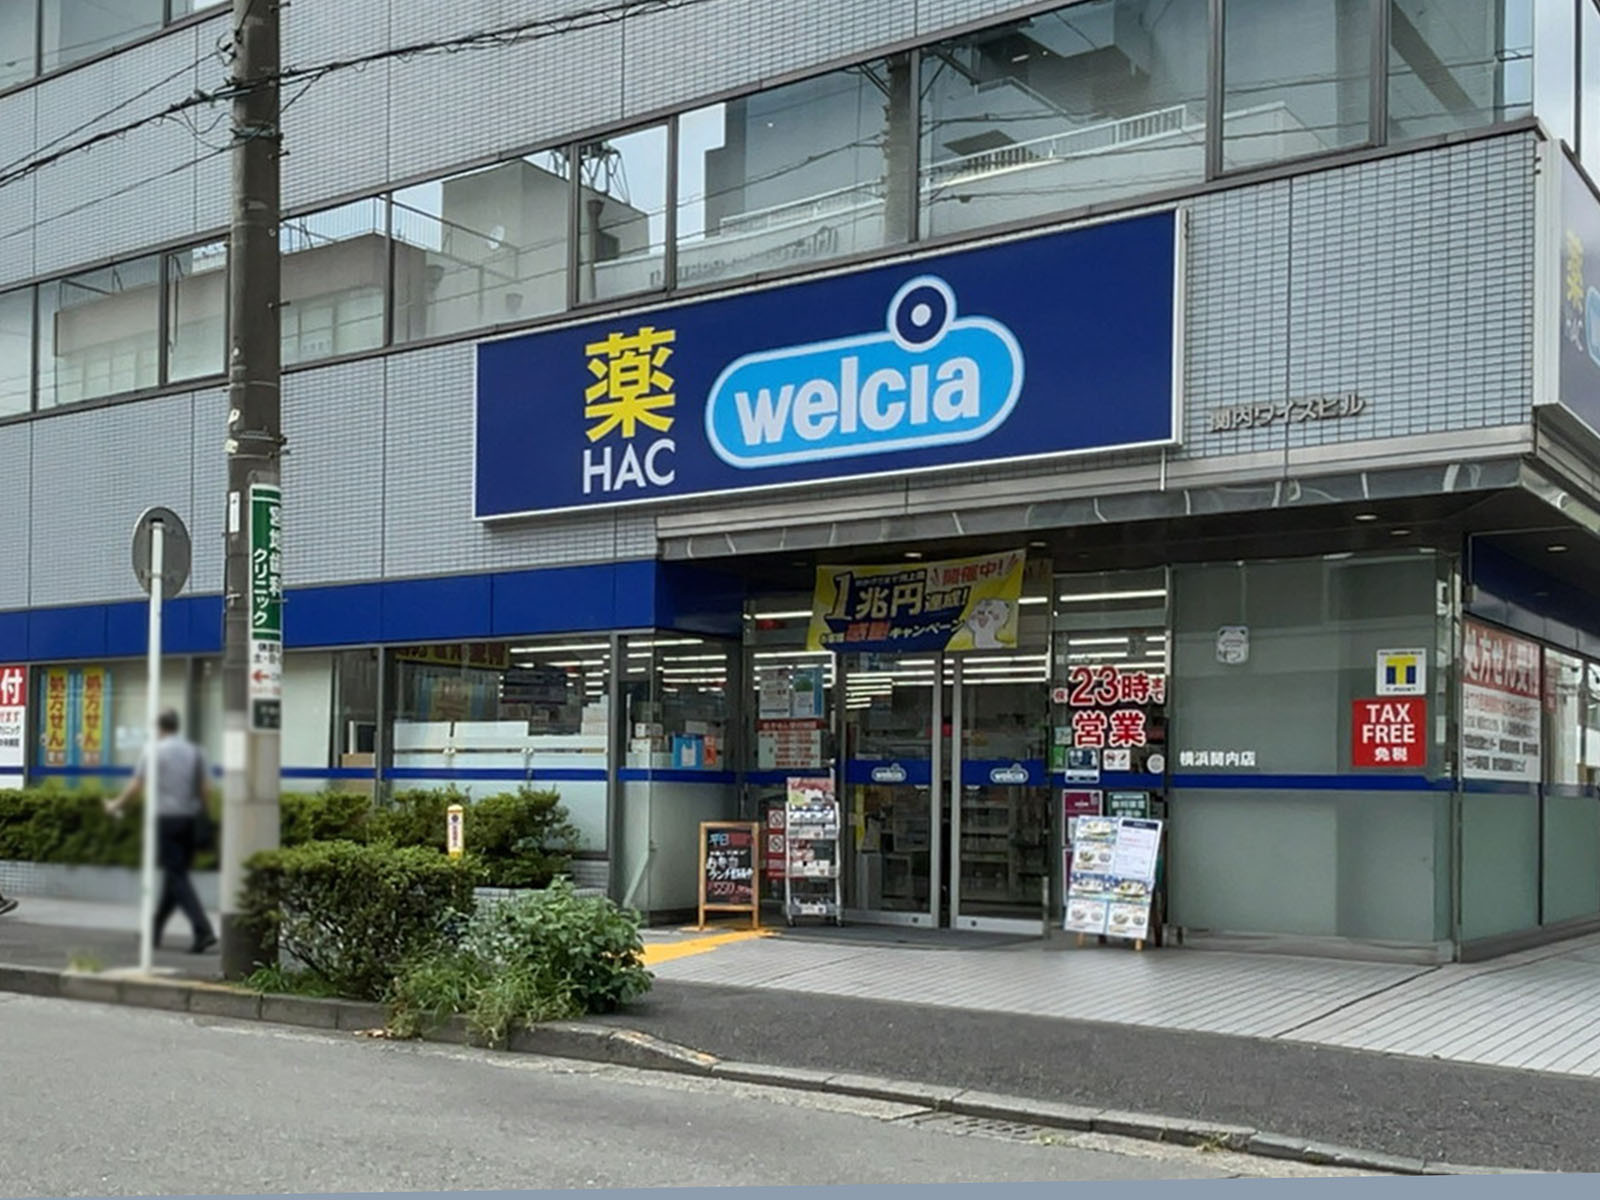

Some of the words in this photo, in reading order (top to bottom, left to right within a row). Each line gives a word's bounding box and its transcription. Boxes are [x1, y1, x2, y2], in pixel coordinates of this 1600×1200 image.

[584, 326, 676, 442] 薬
[734, 356, 980, 446] welcia
[582, 438, 676, 495] HAC
[252, 548, 269, 627] クリニック
[1073, 711, 1146, 747] 営業
[1366, 703, 1411, 723] TAX
[1362, 724, 1415, 744] FREE
[1180, 751, 1256, 767] 横浜関内店
[1375, 747, 1408, 762] 免税
